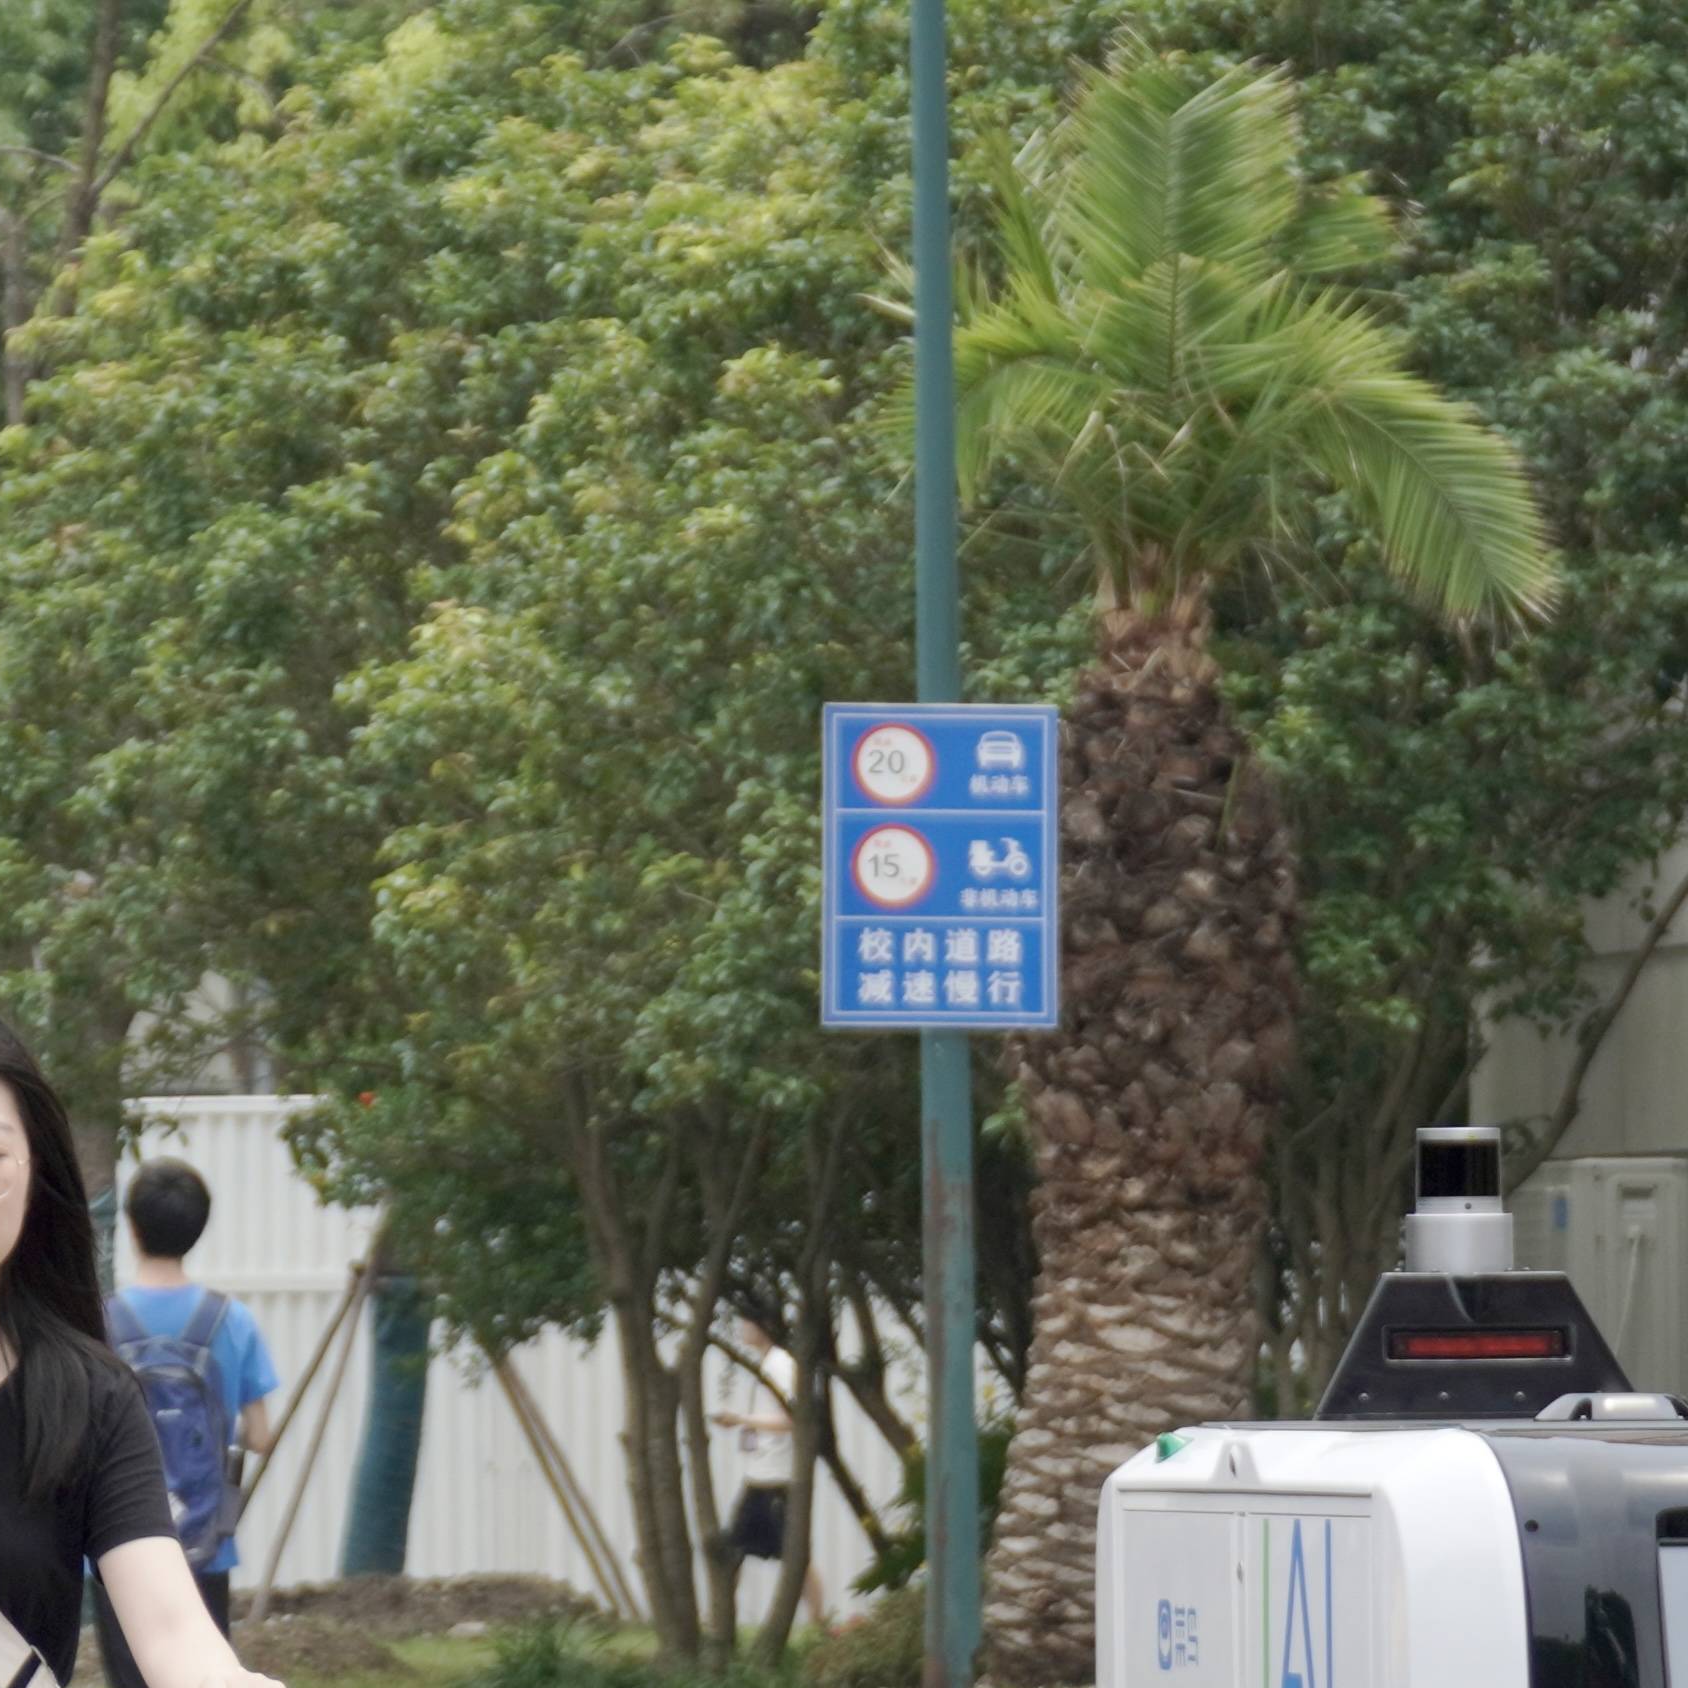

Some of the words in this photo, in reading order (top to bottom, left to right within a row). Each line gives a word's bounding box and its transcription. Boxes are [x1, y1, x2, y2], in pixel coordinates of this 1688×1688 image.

[868, 749, 905, 774] 20
[968, 773, 1029, 795] 机动车
[867, 853, 900, 878] 15
[857, 928, 1023, 964] 校内道路
[857, 970, 1022, 1004] 减速慢行
